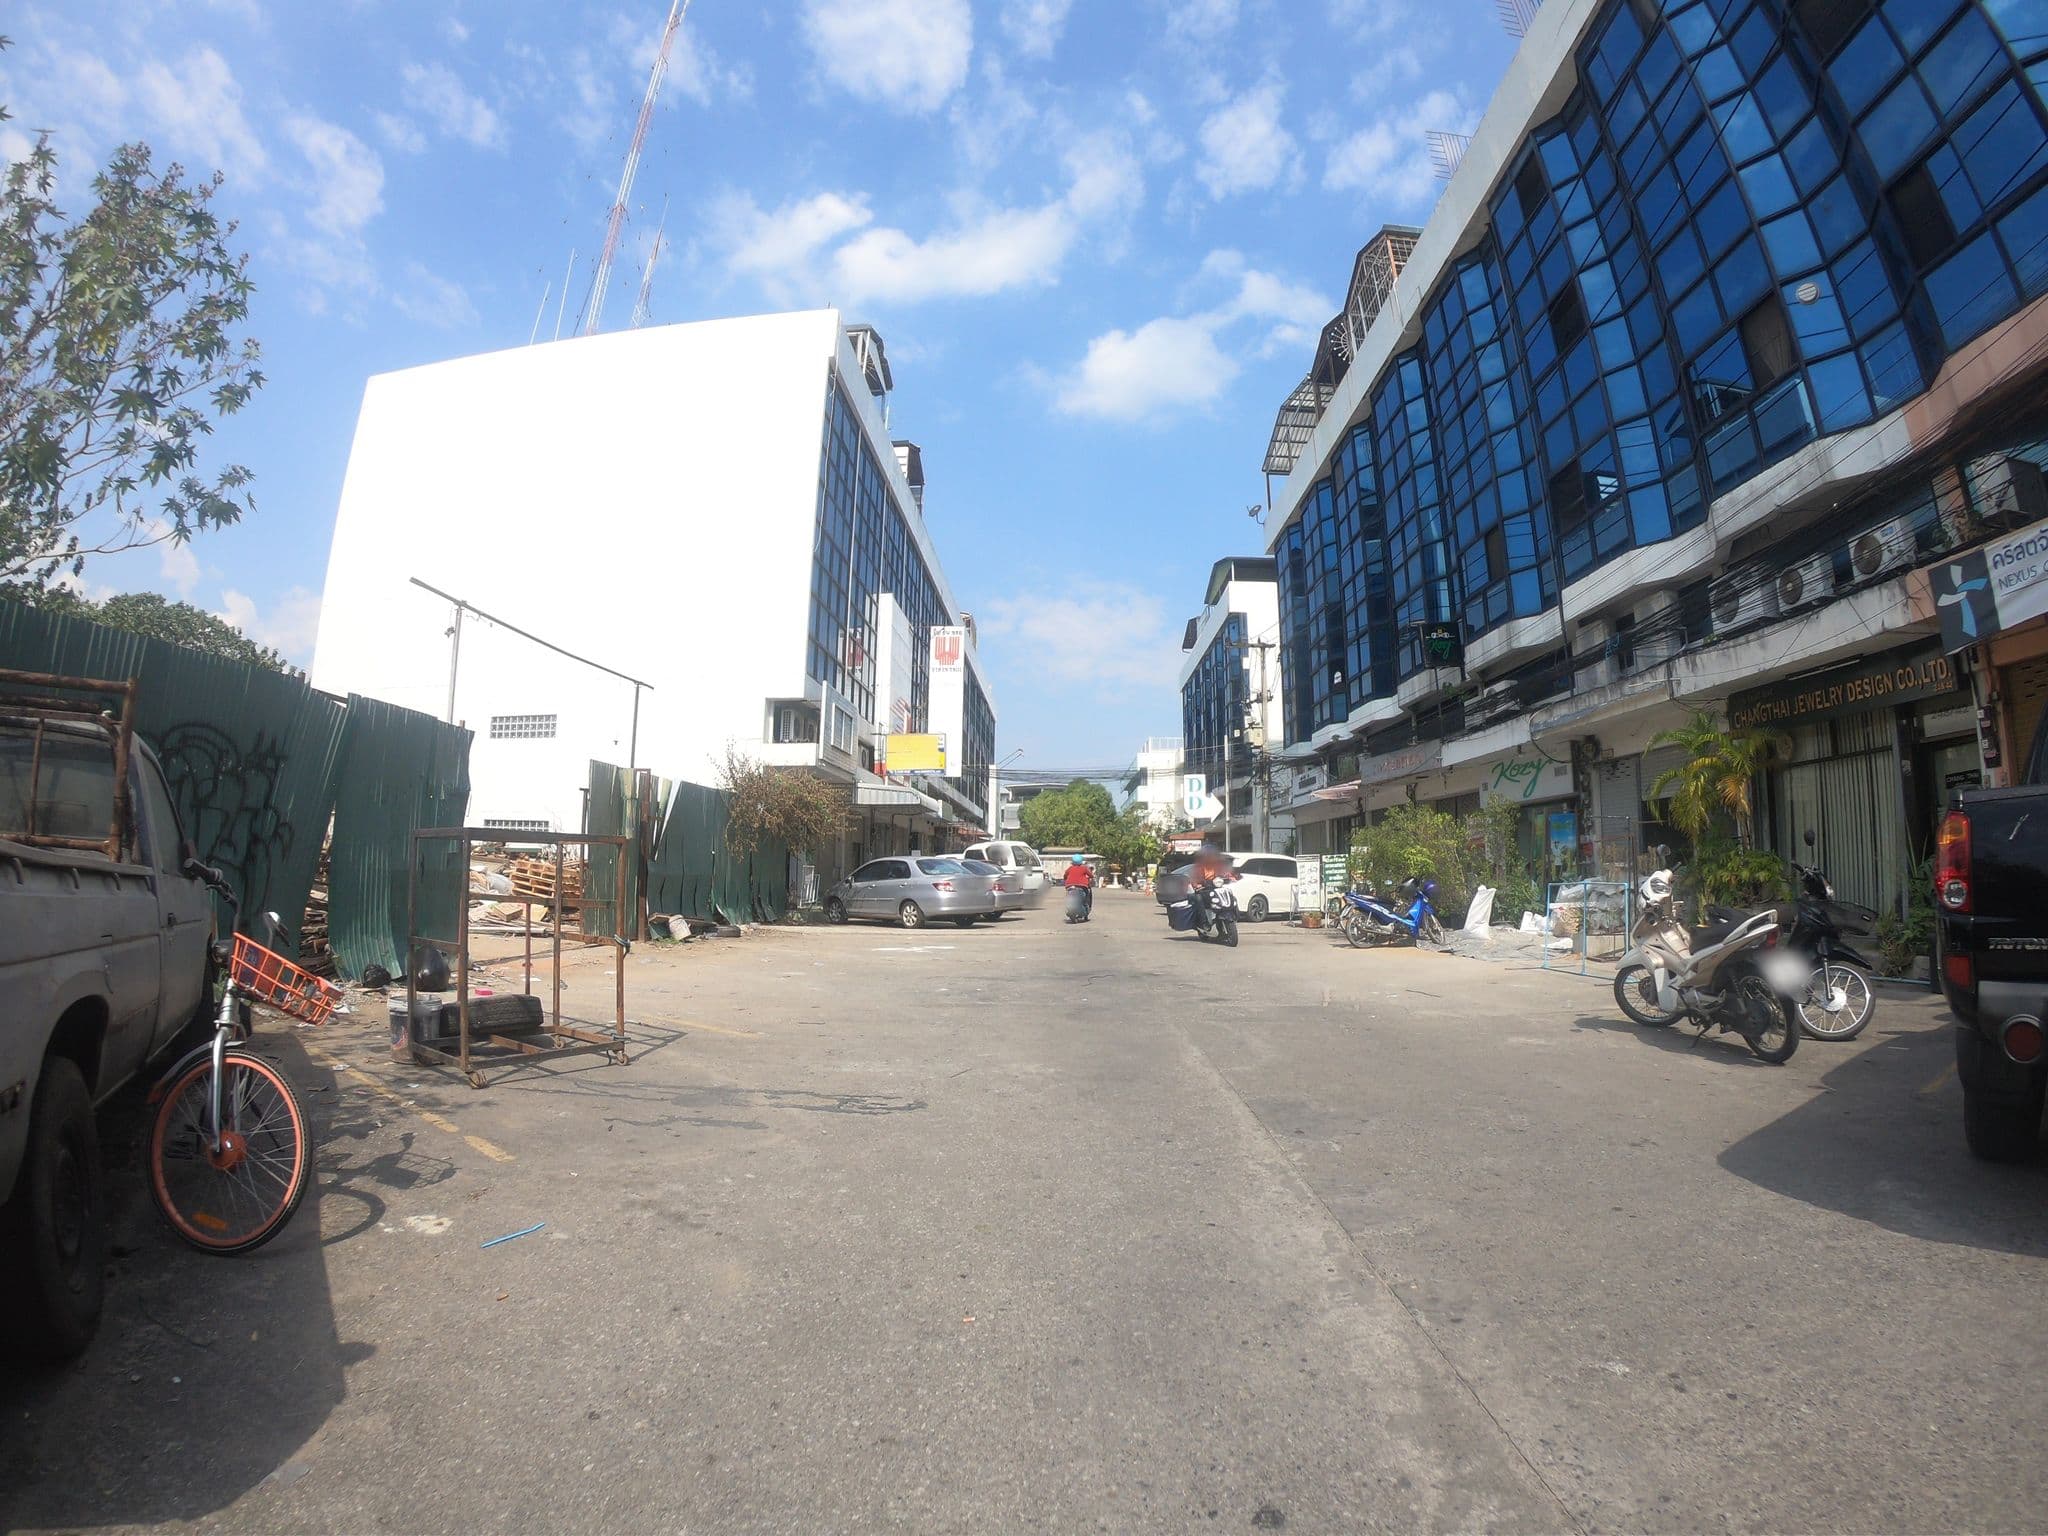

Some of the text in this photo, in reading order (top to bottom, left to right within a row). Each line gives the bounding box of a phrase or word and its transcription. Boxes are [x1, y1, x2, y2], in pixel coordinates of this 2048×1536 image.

[1998, 565, 2038, 590] NEXUS
[1734, 657, 1952, 728] CHANGTHAI JEWELRY DESIGN CO.,LTD.
[1491, 759, 1553, 798] Kozy
